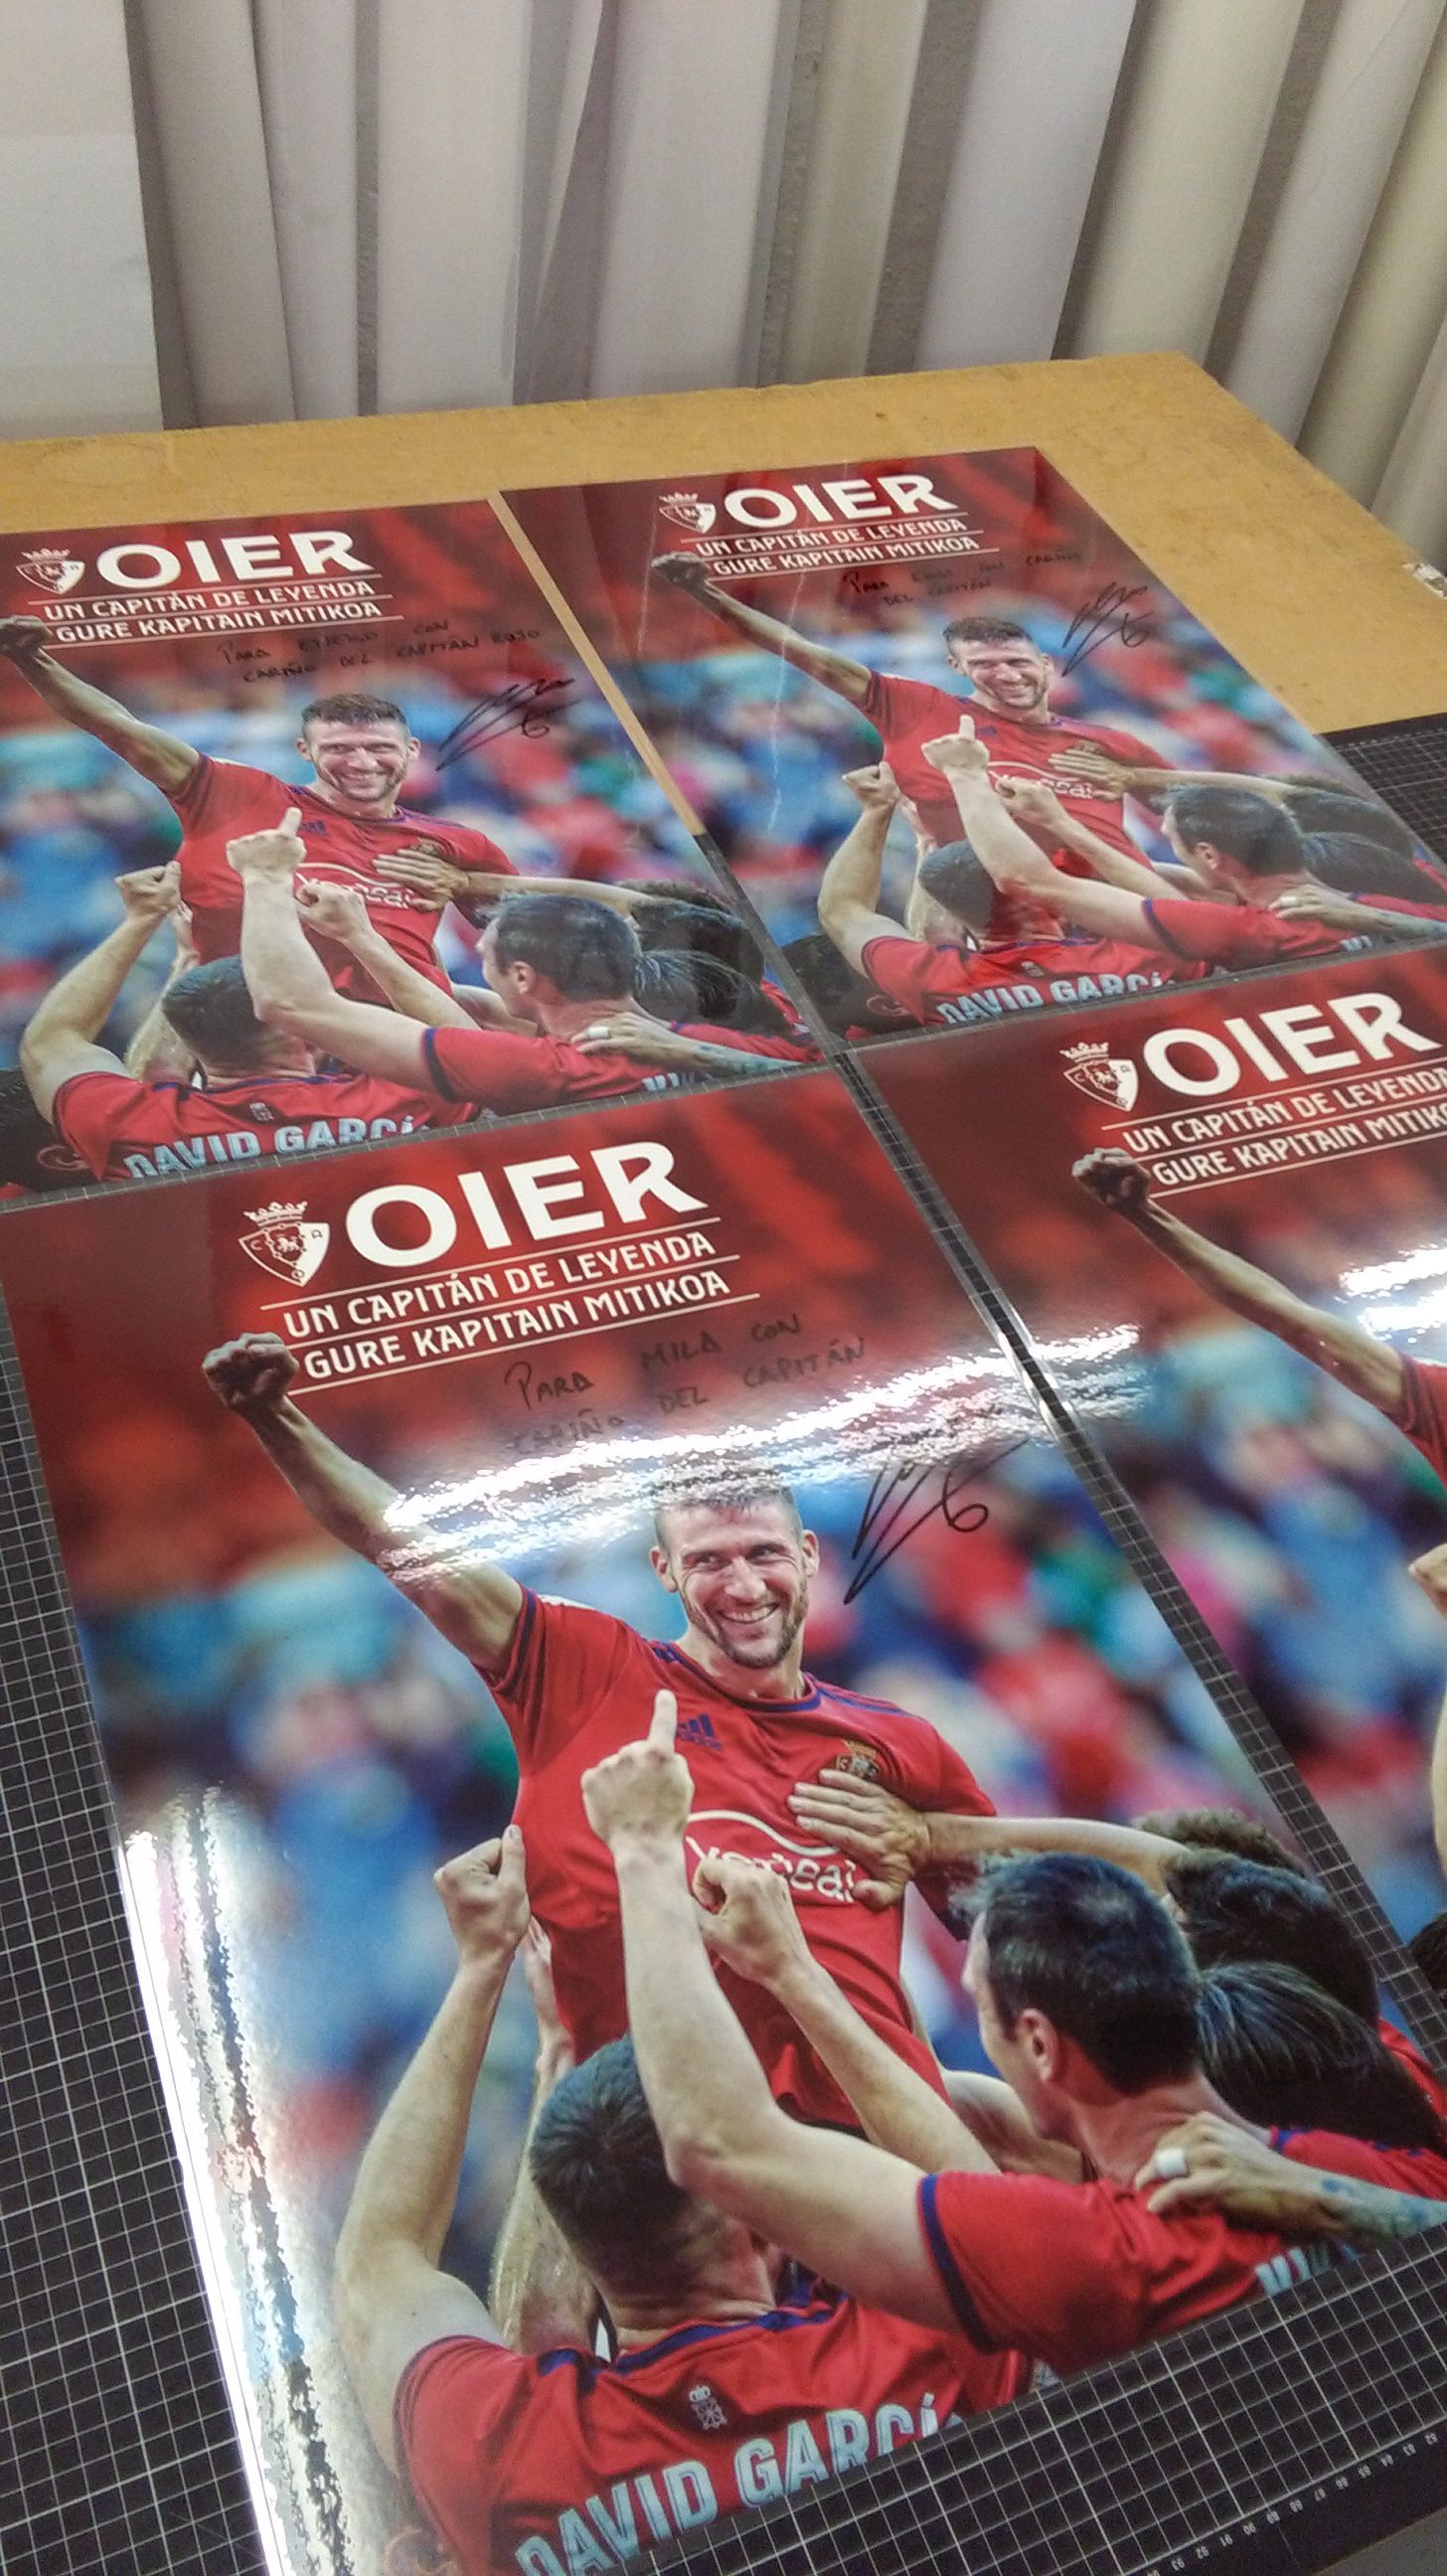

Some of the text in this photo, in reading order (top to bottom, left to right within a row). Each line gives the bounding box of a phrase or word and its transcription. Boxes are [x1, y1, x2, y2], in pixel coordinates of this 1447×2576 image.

[723, 474, 959, 529] OIER
[96, 530, 375, 588] OIER
[696, 518, 968, 557] UN CAPITÁN DE LEYENDA
[713, 536, 980, 576] GURE KAPITAIN MITIKOA
[45, 579, 376, 622] UN CAPITÁN DE LEYENDA
[55, 600, 383, 644] GURE KAPITAIN MITIKOA
[1143, 992, 1443, 1096] OIER
[1123, 1125, 1170, 1153] UN
[1171, 1102, 1293, 1143] CAPITÁN
[1294, 1092, 1328, 1117] DE
[1152, 1150, 1236, 1186] GURE
[1236, 1123, 1367, 1169] KAPITAIN
[346, 1142, 709, 1266] OIER
[283, 1231, 717, 1338] UN CAPITÁN DE LEYENDA
[304, 1270, 729, 1378] GURE KAPITAIN MITIKOA
[641, 1331, 722, 1369] MILA
[751, 1313, 801, 1342] CON
[658, 1387, 710, 1415] DEL
[742, 1338, 866, 1387] CAPITÁN
[1195, 2545, 1209, 2559] 92
[1218, 2533, 1233, 2547] 91
[1242, 2521, 1256, 2535] 90
[1171, 2556, 1186, 2570] 93
